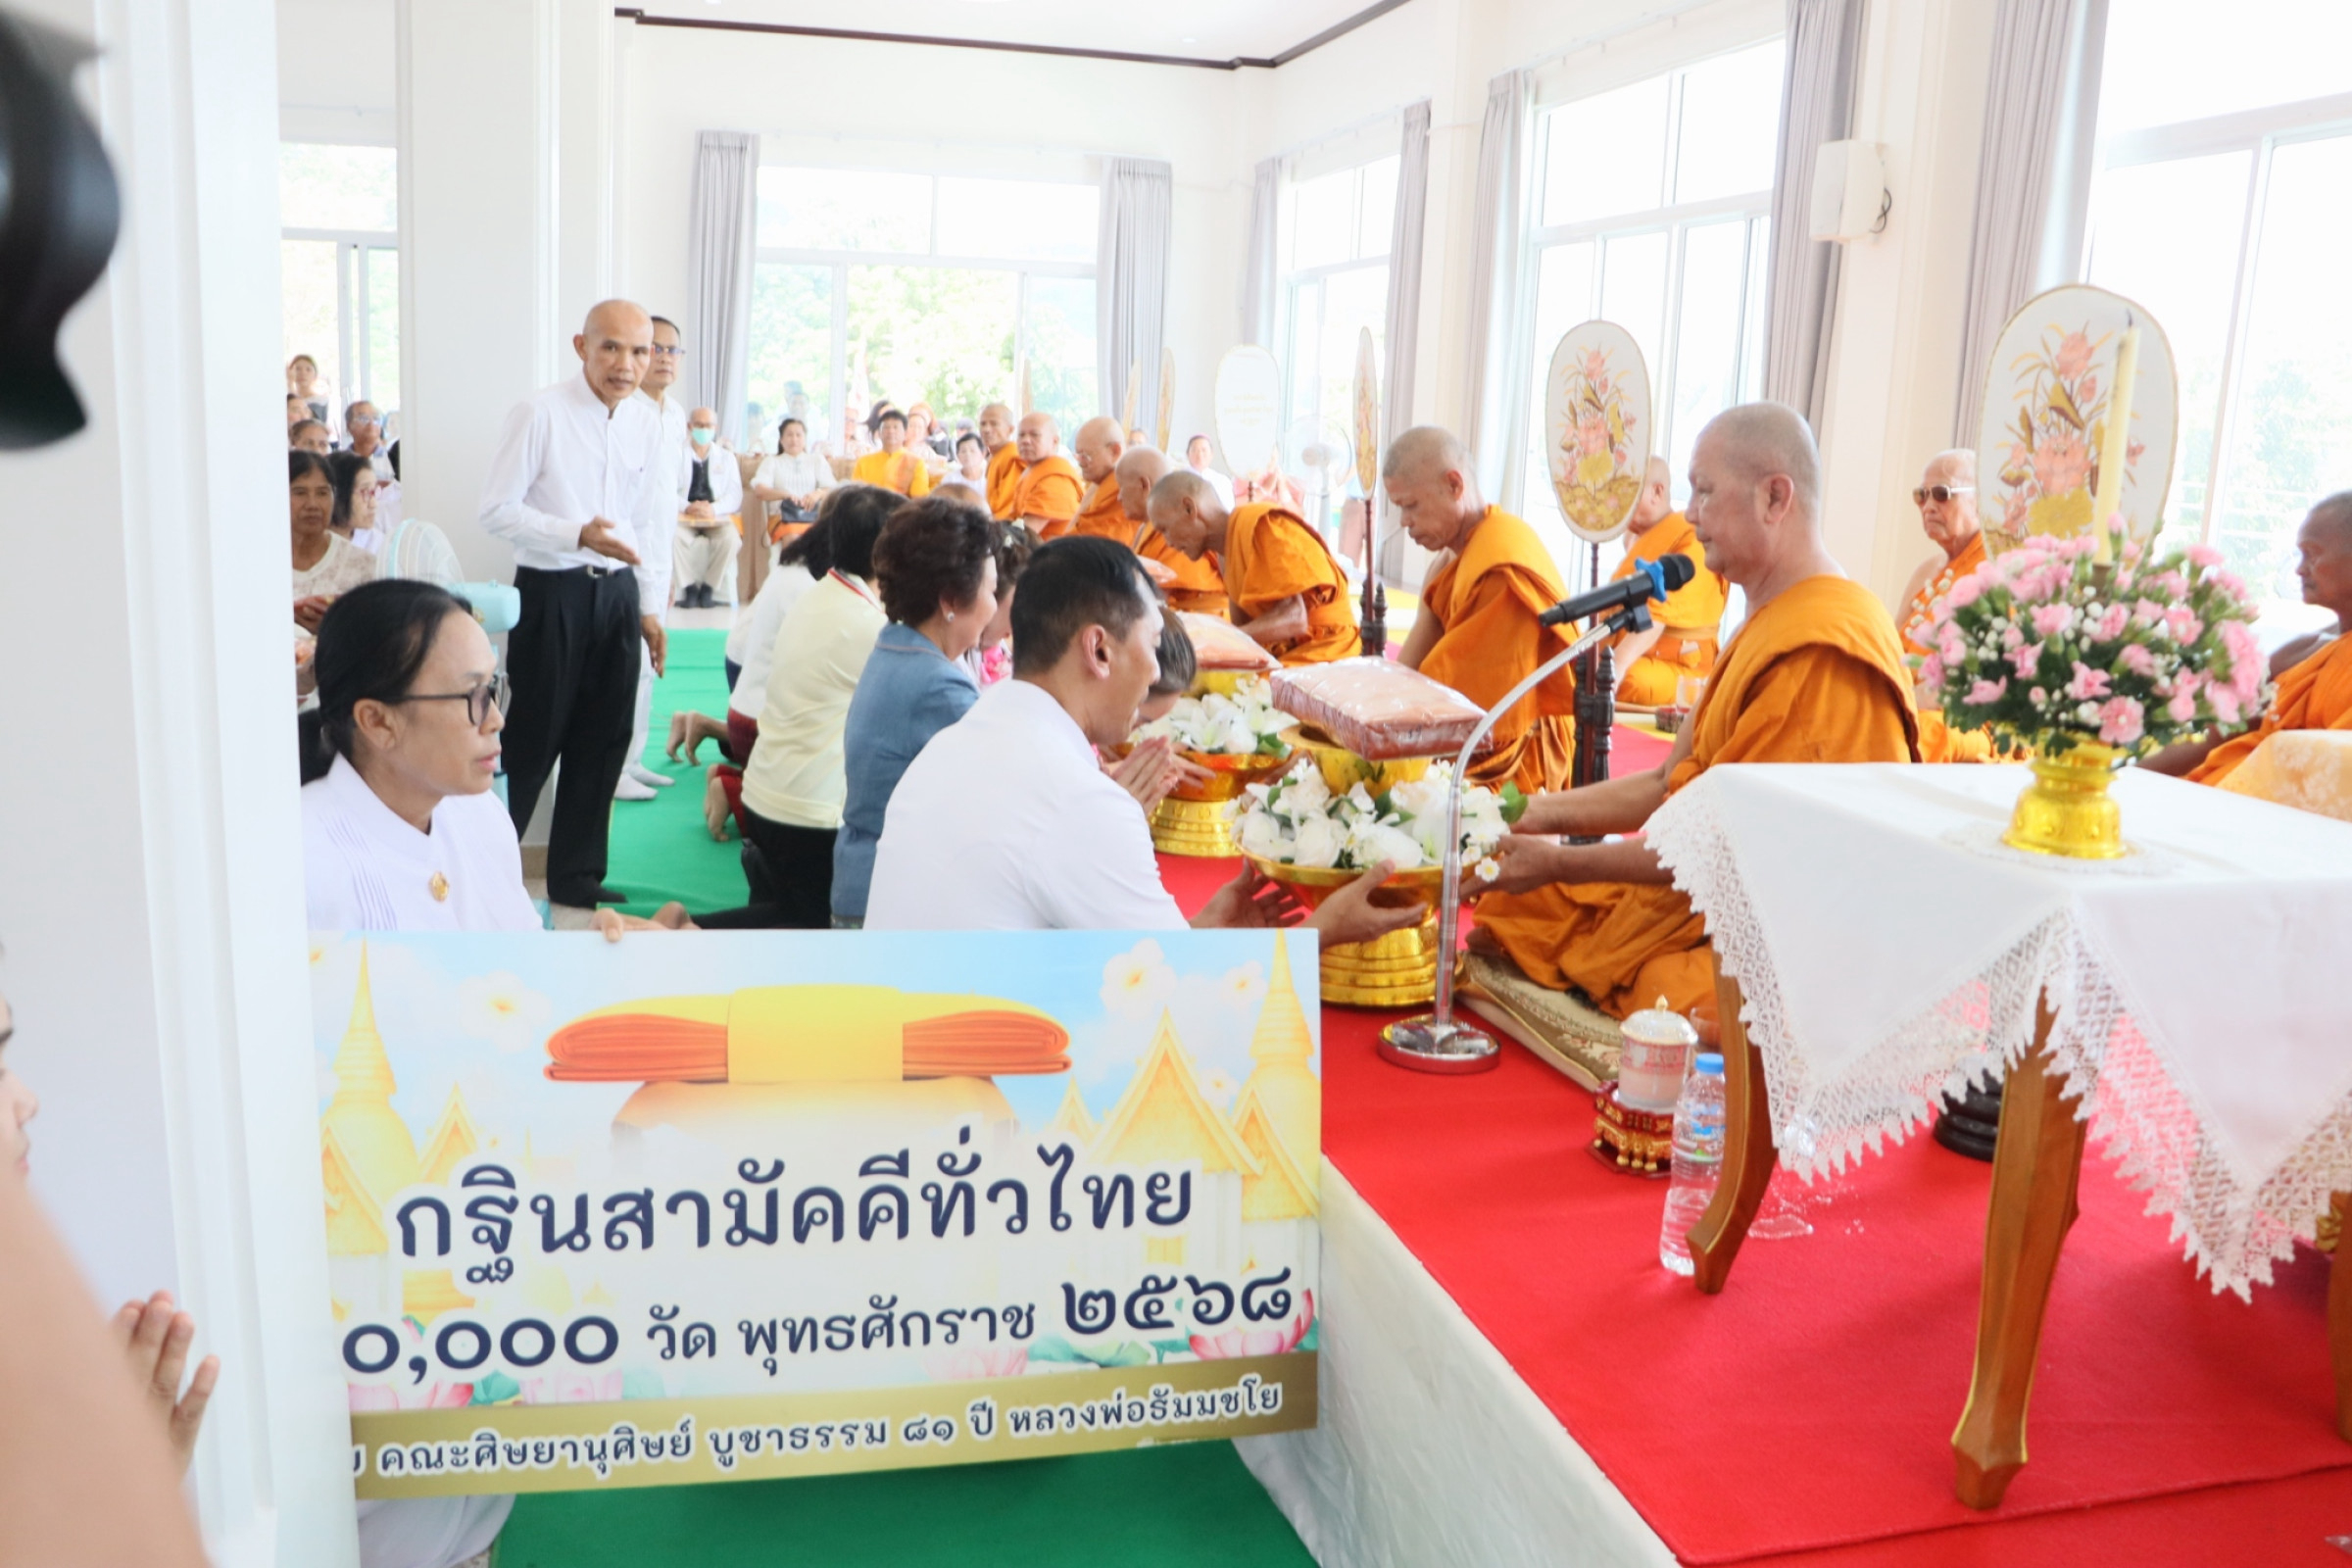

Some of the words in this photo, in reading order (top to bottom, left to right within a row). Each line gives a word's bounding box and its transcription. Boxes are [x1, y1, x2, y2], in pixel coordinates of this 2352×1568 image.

[395, 1124, 1193, 1284] กฐินสามัคคีทั่วไทย
[647, 1304, 716, 1360] วัด
[737, 1295, 1036, 1377] พุทธศักราช
[1060, 1266, 1292, 1336] ๒๕๖๘
[381, 1419, 691, 1475] คณะศิษยานุศิษย์
[709, 1422, 886, 1468] บูชาธรรม
[904, 1418, 955, 1445] ๘๑
[970, 1401, 993, 1436] ปี
[1009, 1378, 1279, 1433] หลวงพ่อธัมมชโย
